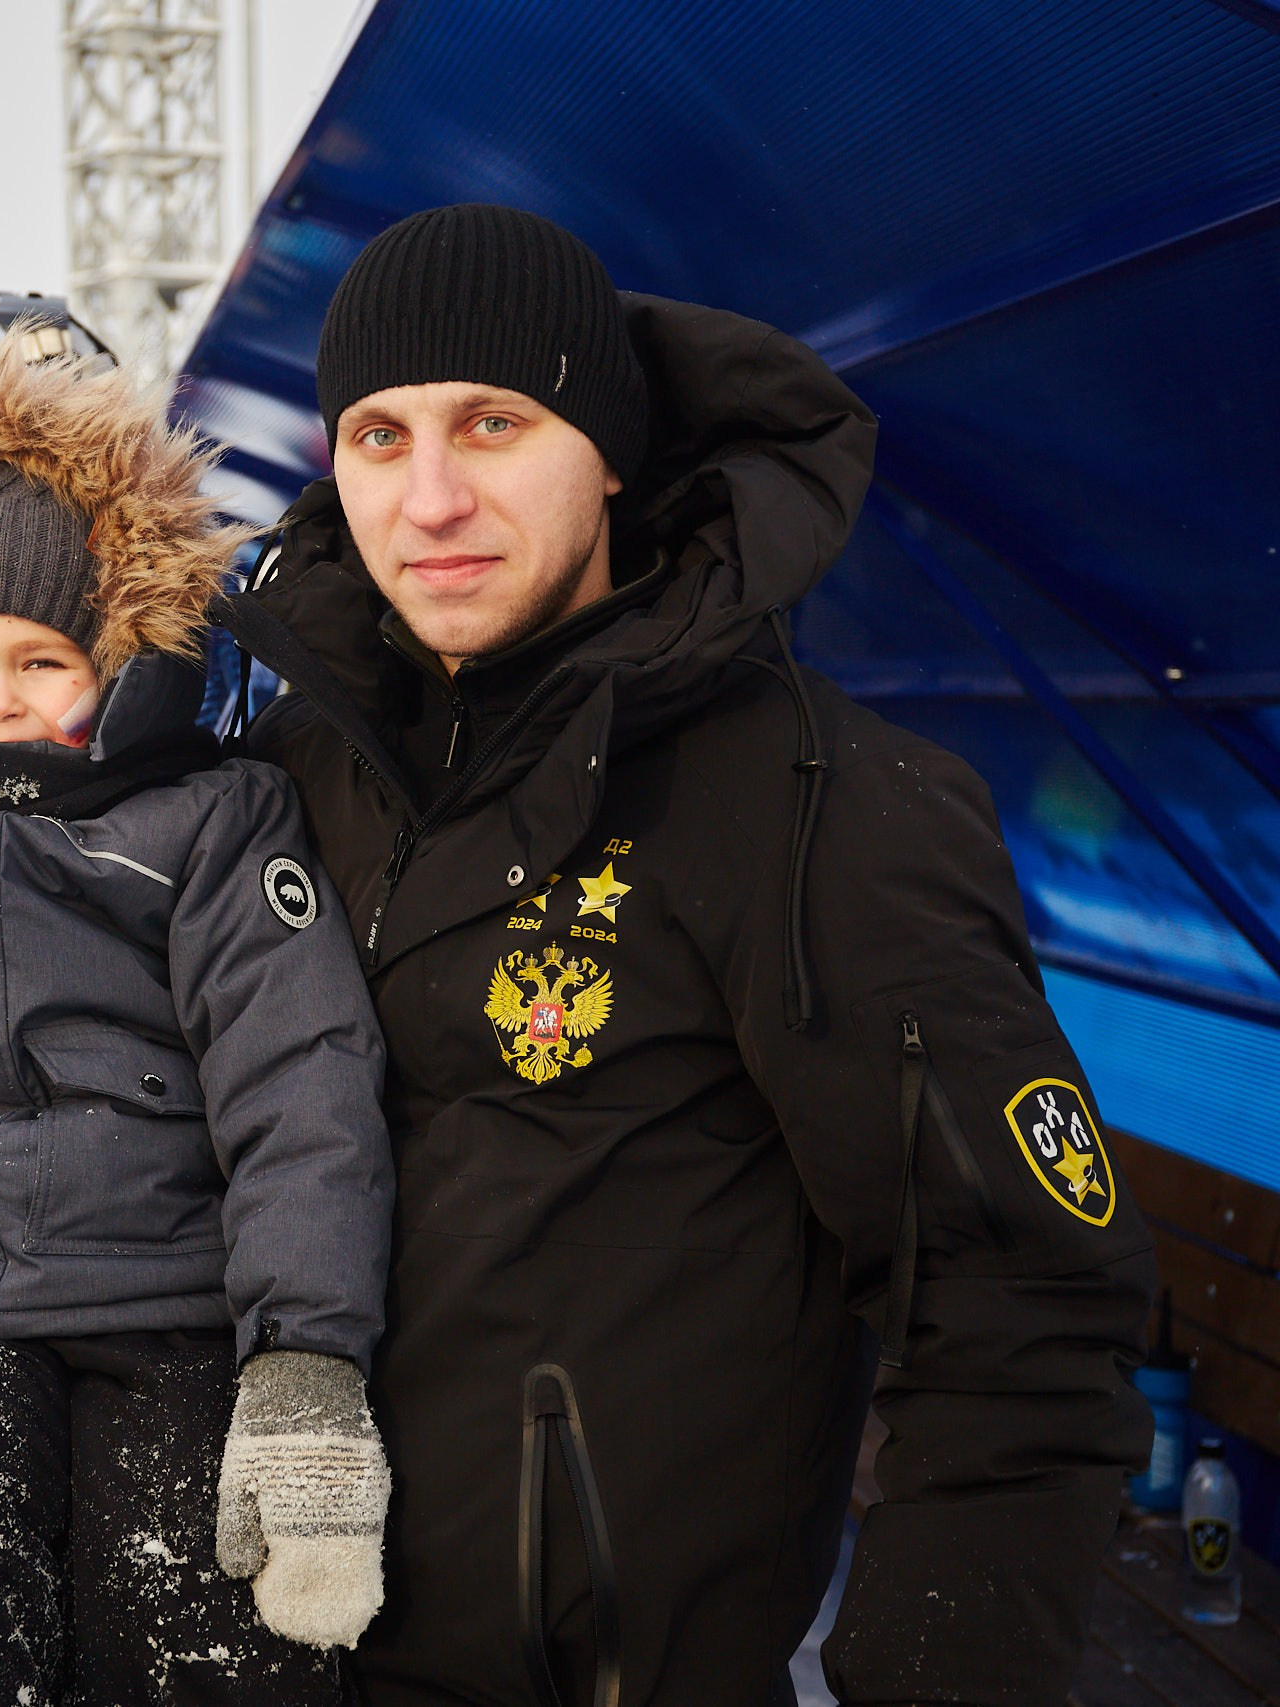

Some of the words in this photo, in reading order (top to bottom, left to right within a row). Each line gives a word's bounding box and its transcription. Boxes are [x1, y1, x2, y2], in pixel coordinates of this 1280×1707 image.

[602, 838, 633, 855] Д2
[266, 860, 283, 883] MOUNTAIN
[283, 860, 311, 889] EXPEDITIONS
[271, 898, 283, 914] WILD
[283, 913, 295, 924] LIFE
[296, 905, 315, 926] ADVENTURES
[506, 916, 543, 931] 2024
[569, 924, 618, 944] 2024
